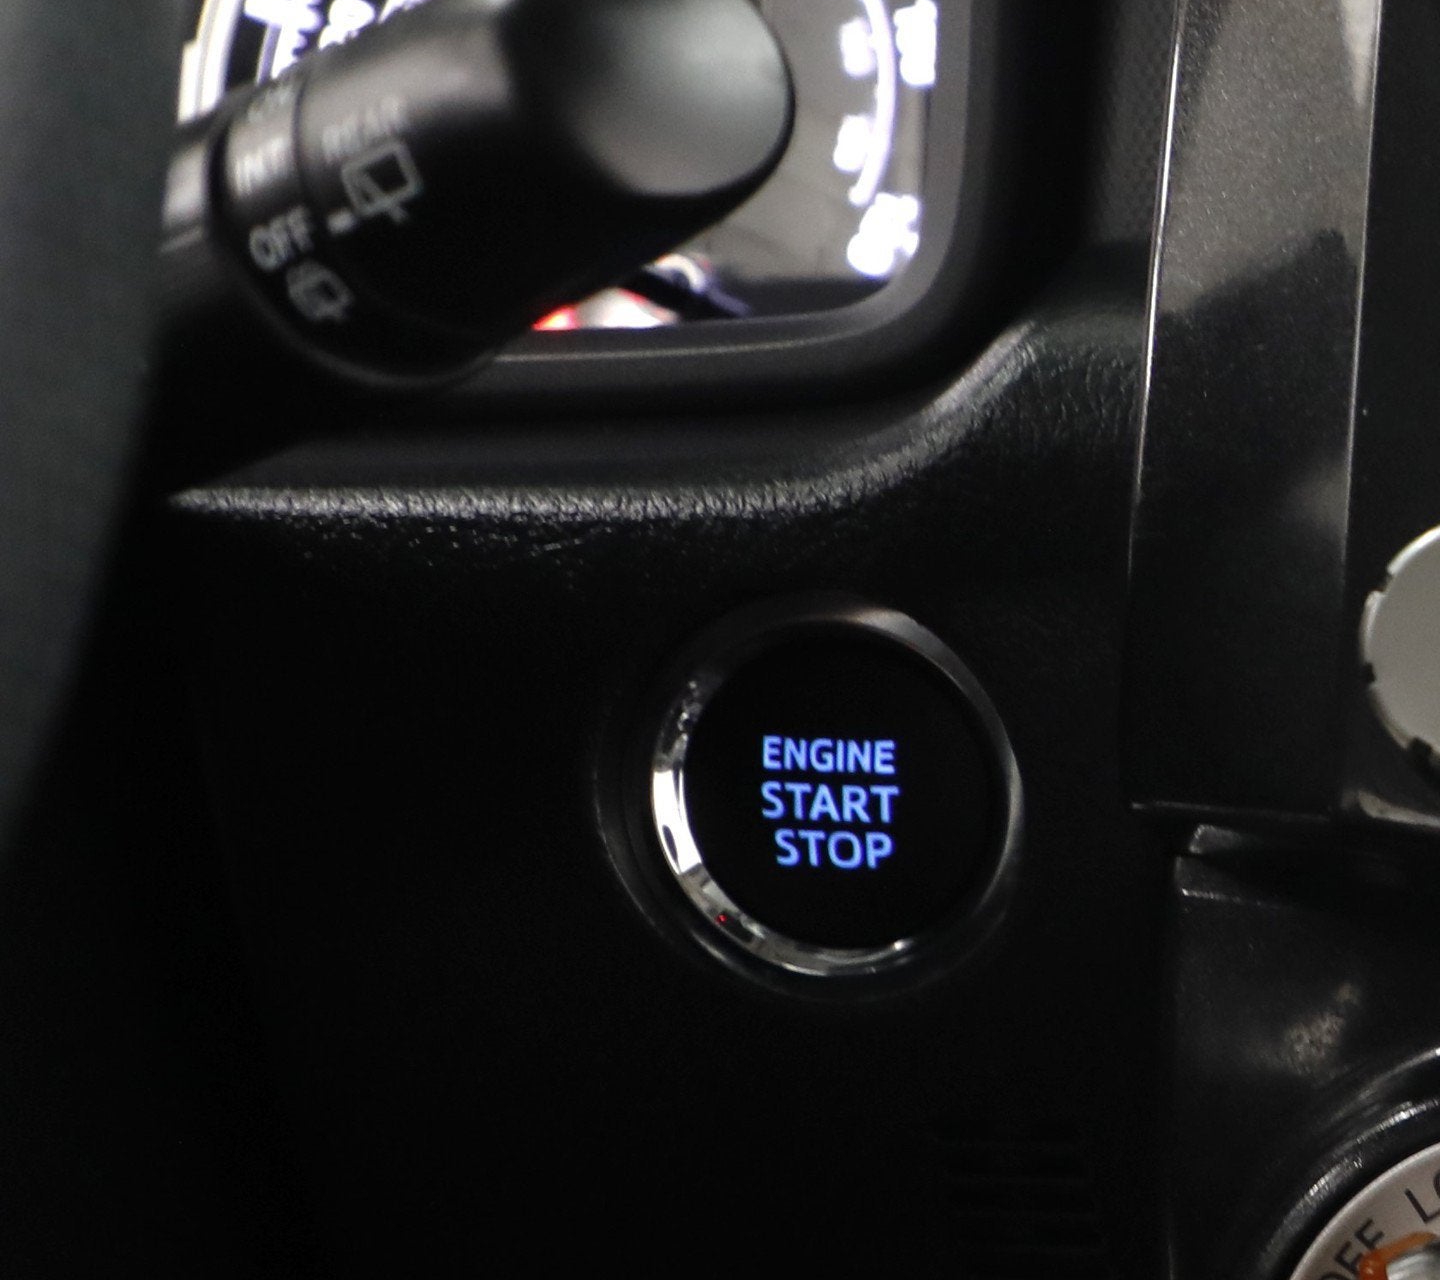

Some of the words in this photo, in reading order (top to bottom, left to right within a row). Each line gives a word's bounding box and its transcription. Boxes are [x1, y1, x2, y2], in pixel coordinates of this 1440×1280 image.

[761, 735, 896, 775] ENGINE
[760, 781, 900, 823] START
[773, 828, 894, 869] STOP
